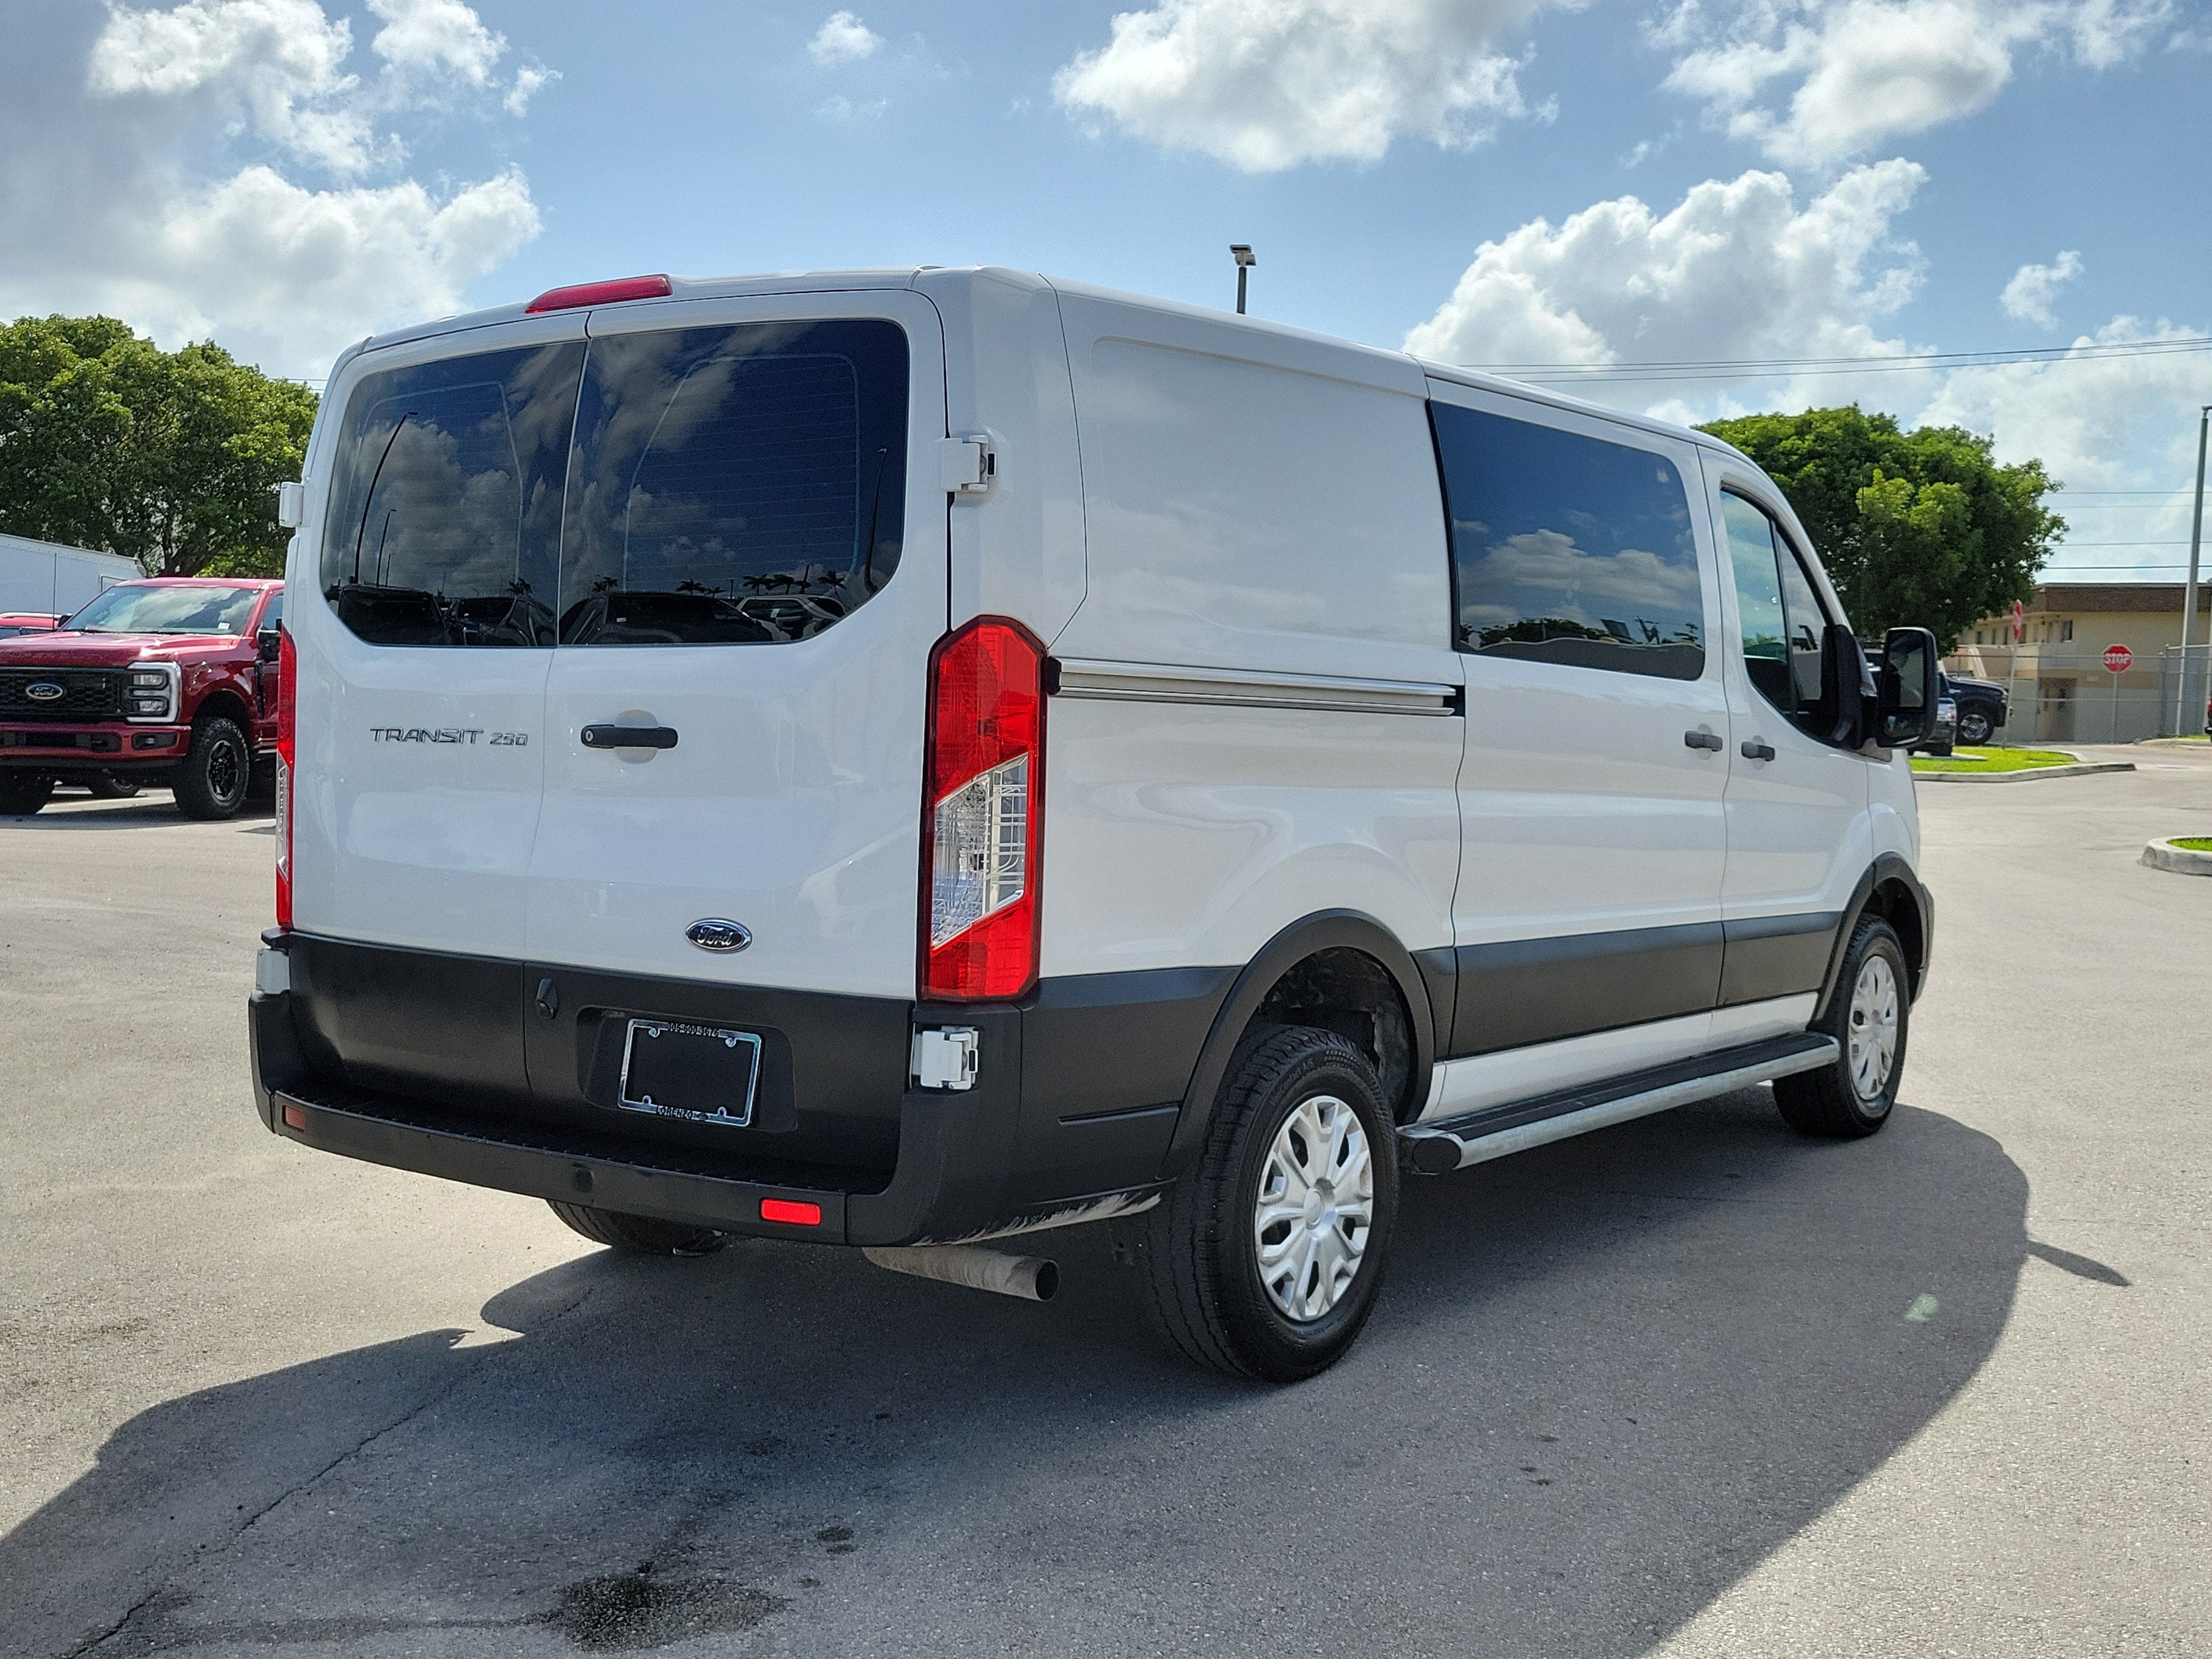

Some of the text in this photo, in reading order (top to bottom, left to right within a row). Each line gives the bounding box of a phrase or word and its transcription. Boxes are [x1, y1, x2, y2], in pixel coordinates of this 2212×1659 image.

[2104, 653, 2131, 664] STOP
[35, 687, 54, 696] Ford
[370, 728, 528, 746] TRANSIT 250
[697, 925, 733, 946] Ford
